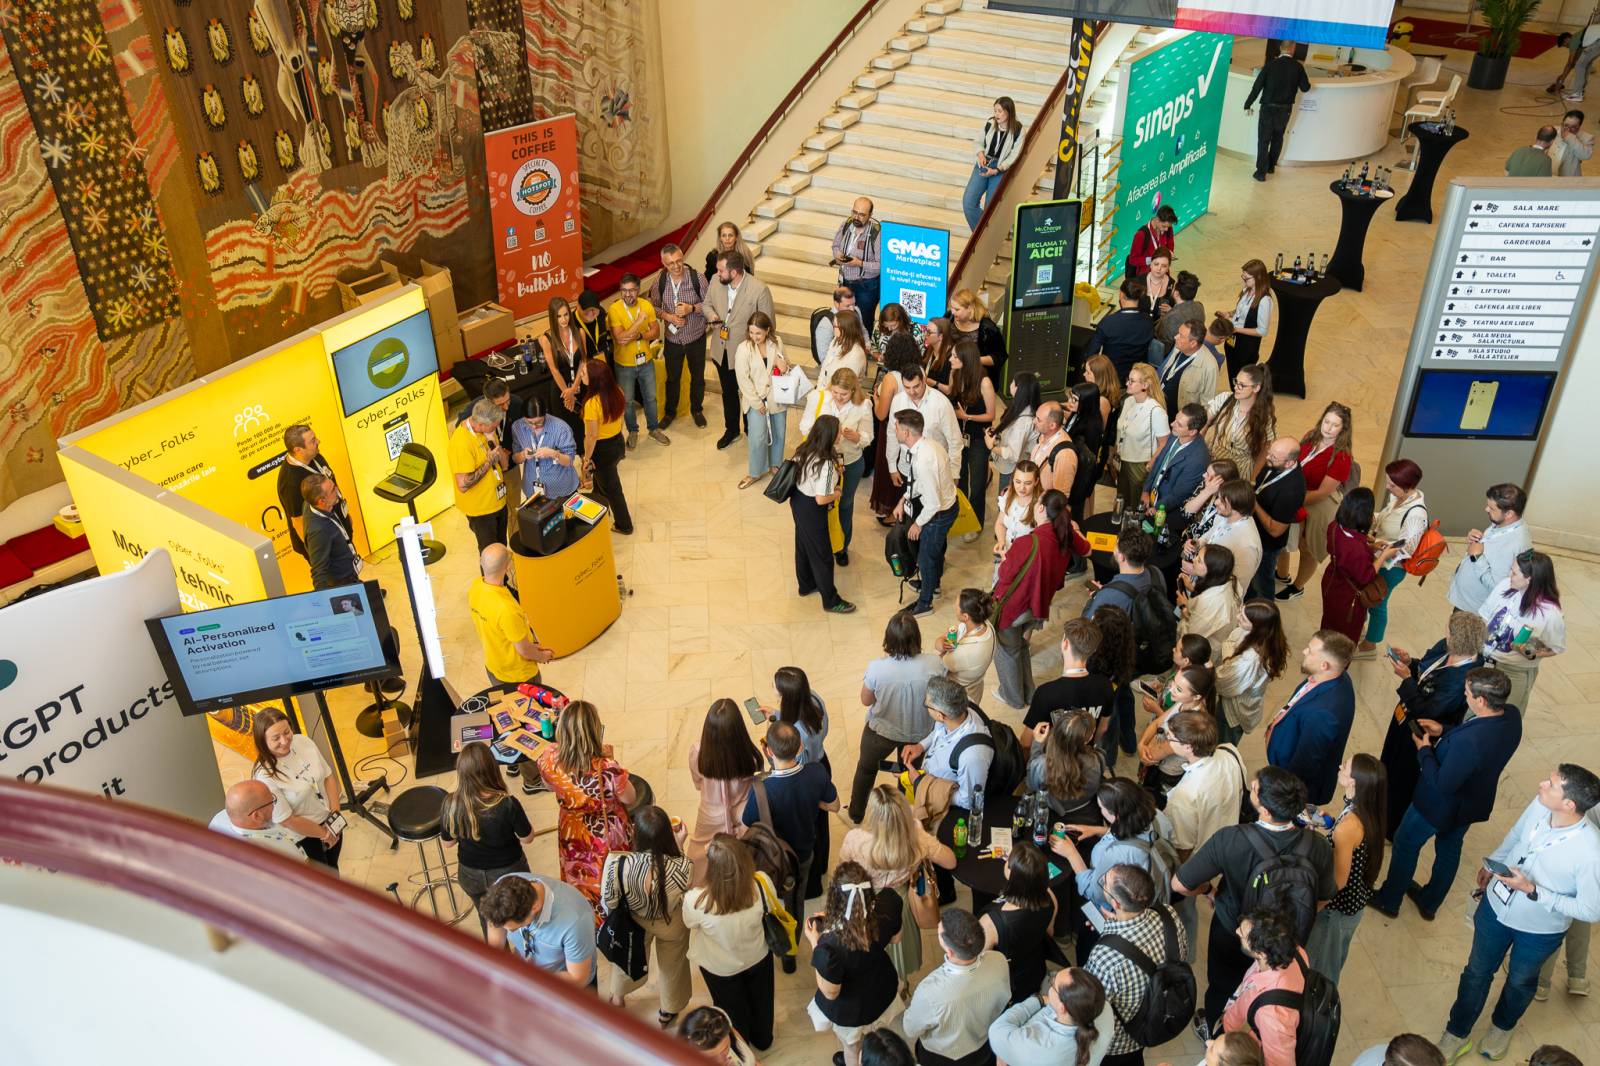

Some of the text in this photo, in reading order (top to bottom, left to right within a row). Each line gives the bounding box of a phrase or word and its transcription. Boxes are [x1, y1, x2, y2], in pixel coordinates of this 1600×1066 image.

[1133, 87, 1196, 150] sinaps
[512, 128, 554, 145] THIS IS
[512, 140, 556, 160] COFFEE
[522, 180, 552, 195] HOTSPOT
[1126, 174, 1160, 207] Afacerea
[528, 203, 548, 214] COFFEE
[887, 238, 941, 260] eMAG
[1029, 246, 1063, 260] AICI!
[896, 254, 940, 267] Marketplace
[517, 268, 568, 298] Bullshit
[187, 638, 246, 656] Activation
[0, 684, 85, 750] GPT
